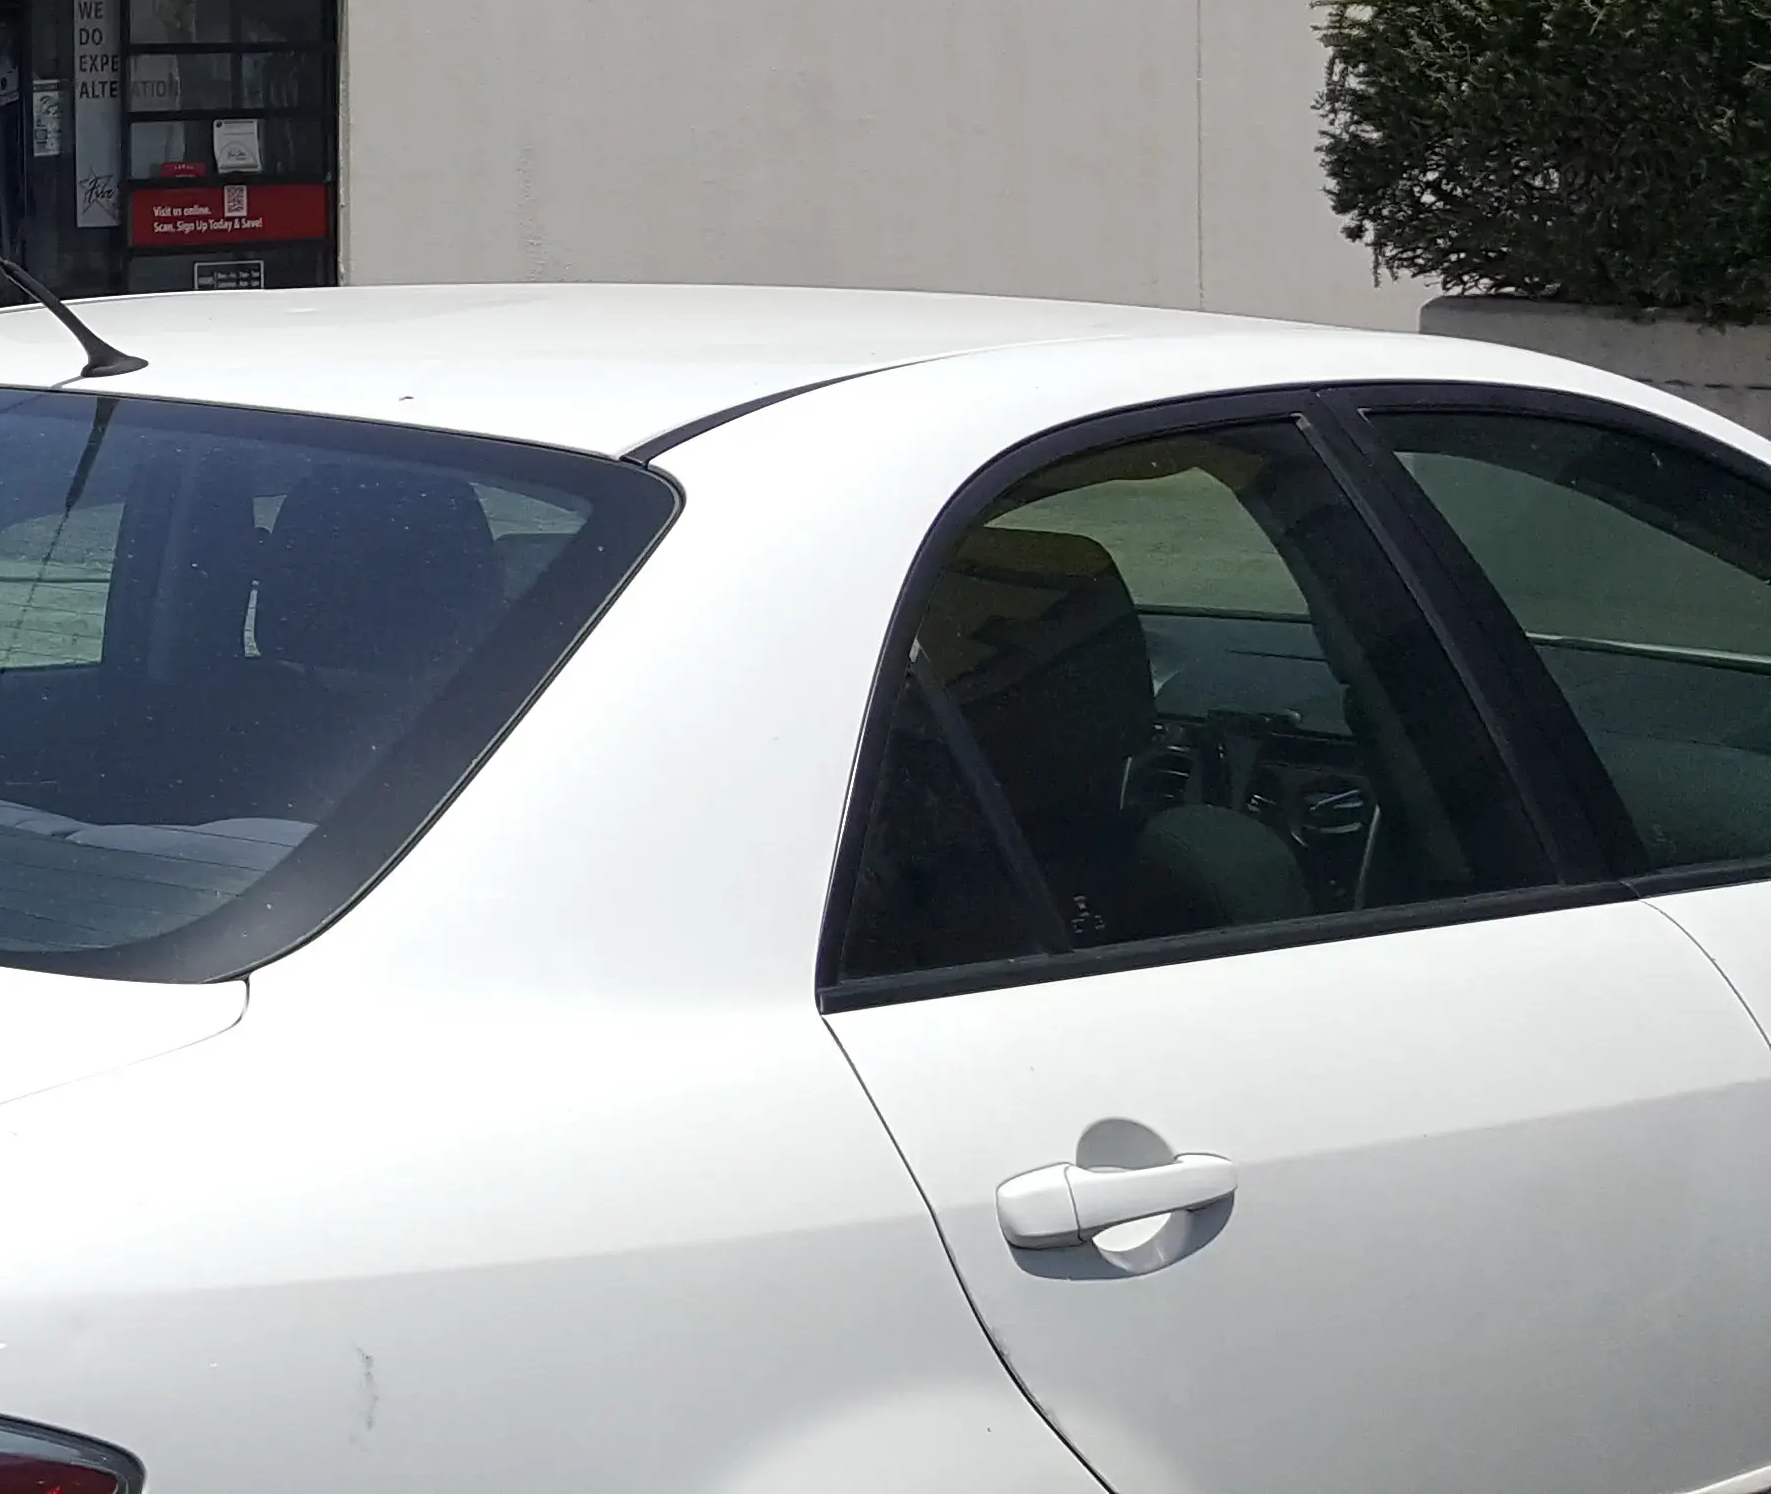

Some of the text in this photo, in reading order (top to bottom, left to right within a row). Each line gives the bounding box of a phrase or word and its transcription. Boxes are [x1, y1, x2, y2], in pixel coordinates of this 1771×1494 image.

[78, 1, 104, 20] WE
[79, 28, 104, 46] DO
[79, 54, 127, 73] EXPE
[195, 220, 208, 233] Up
[208, 218, 233, 232] Today
